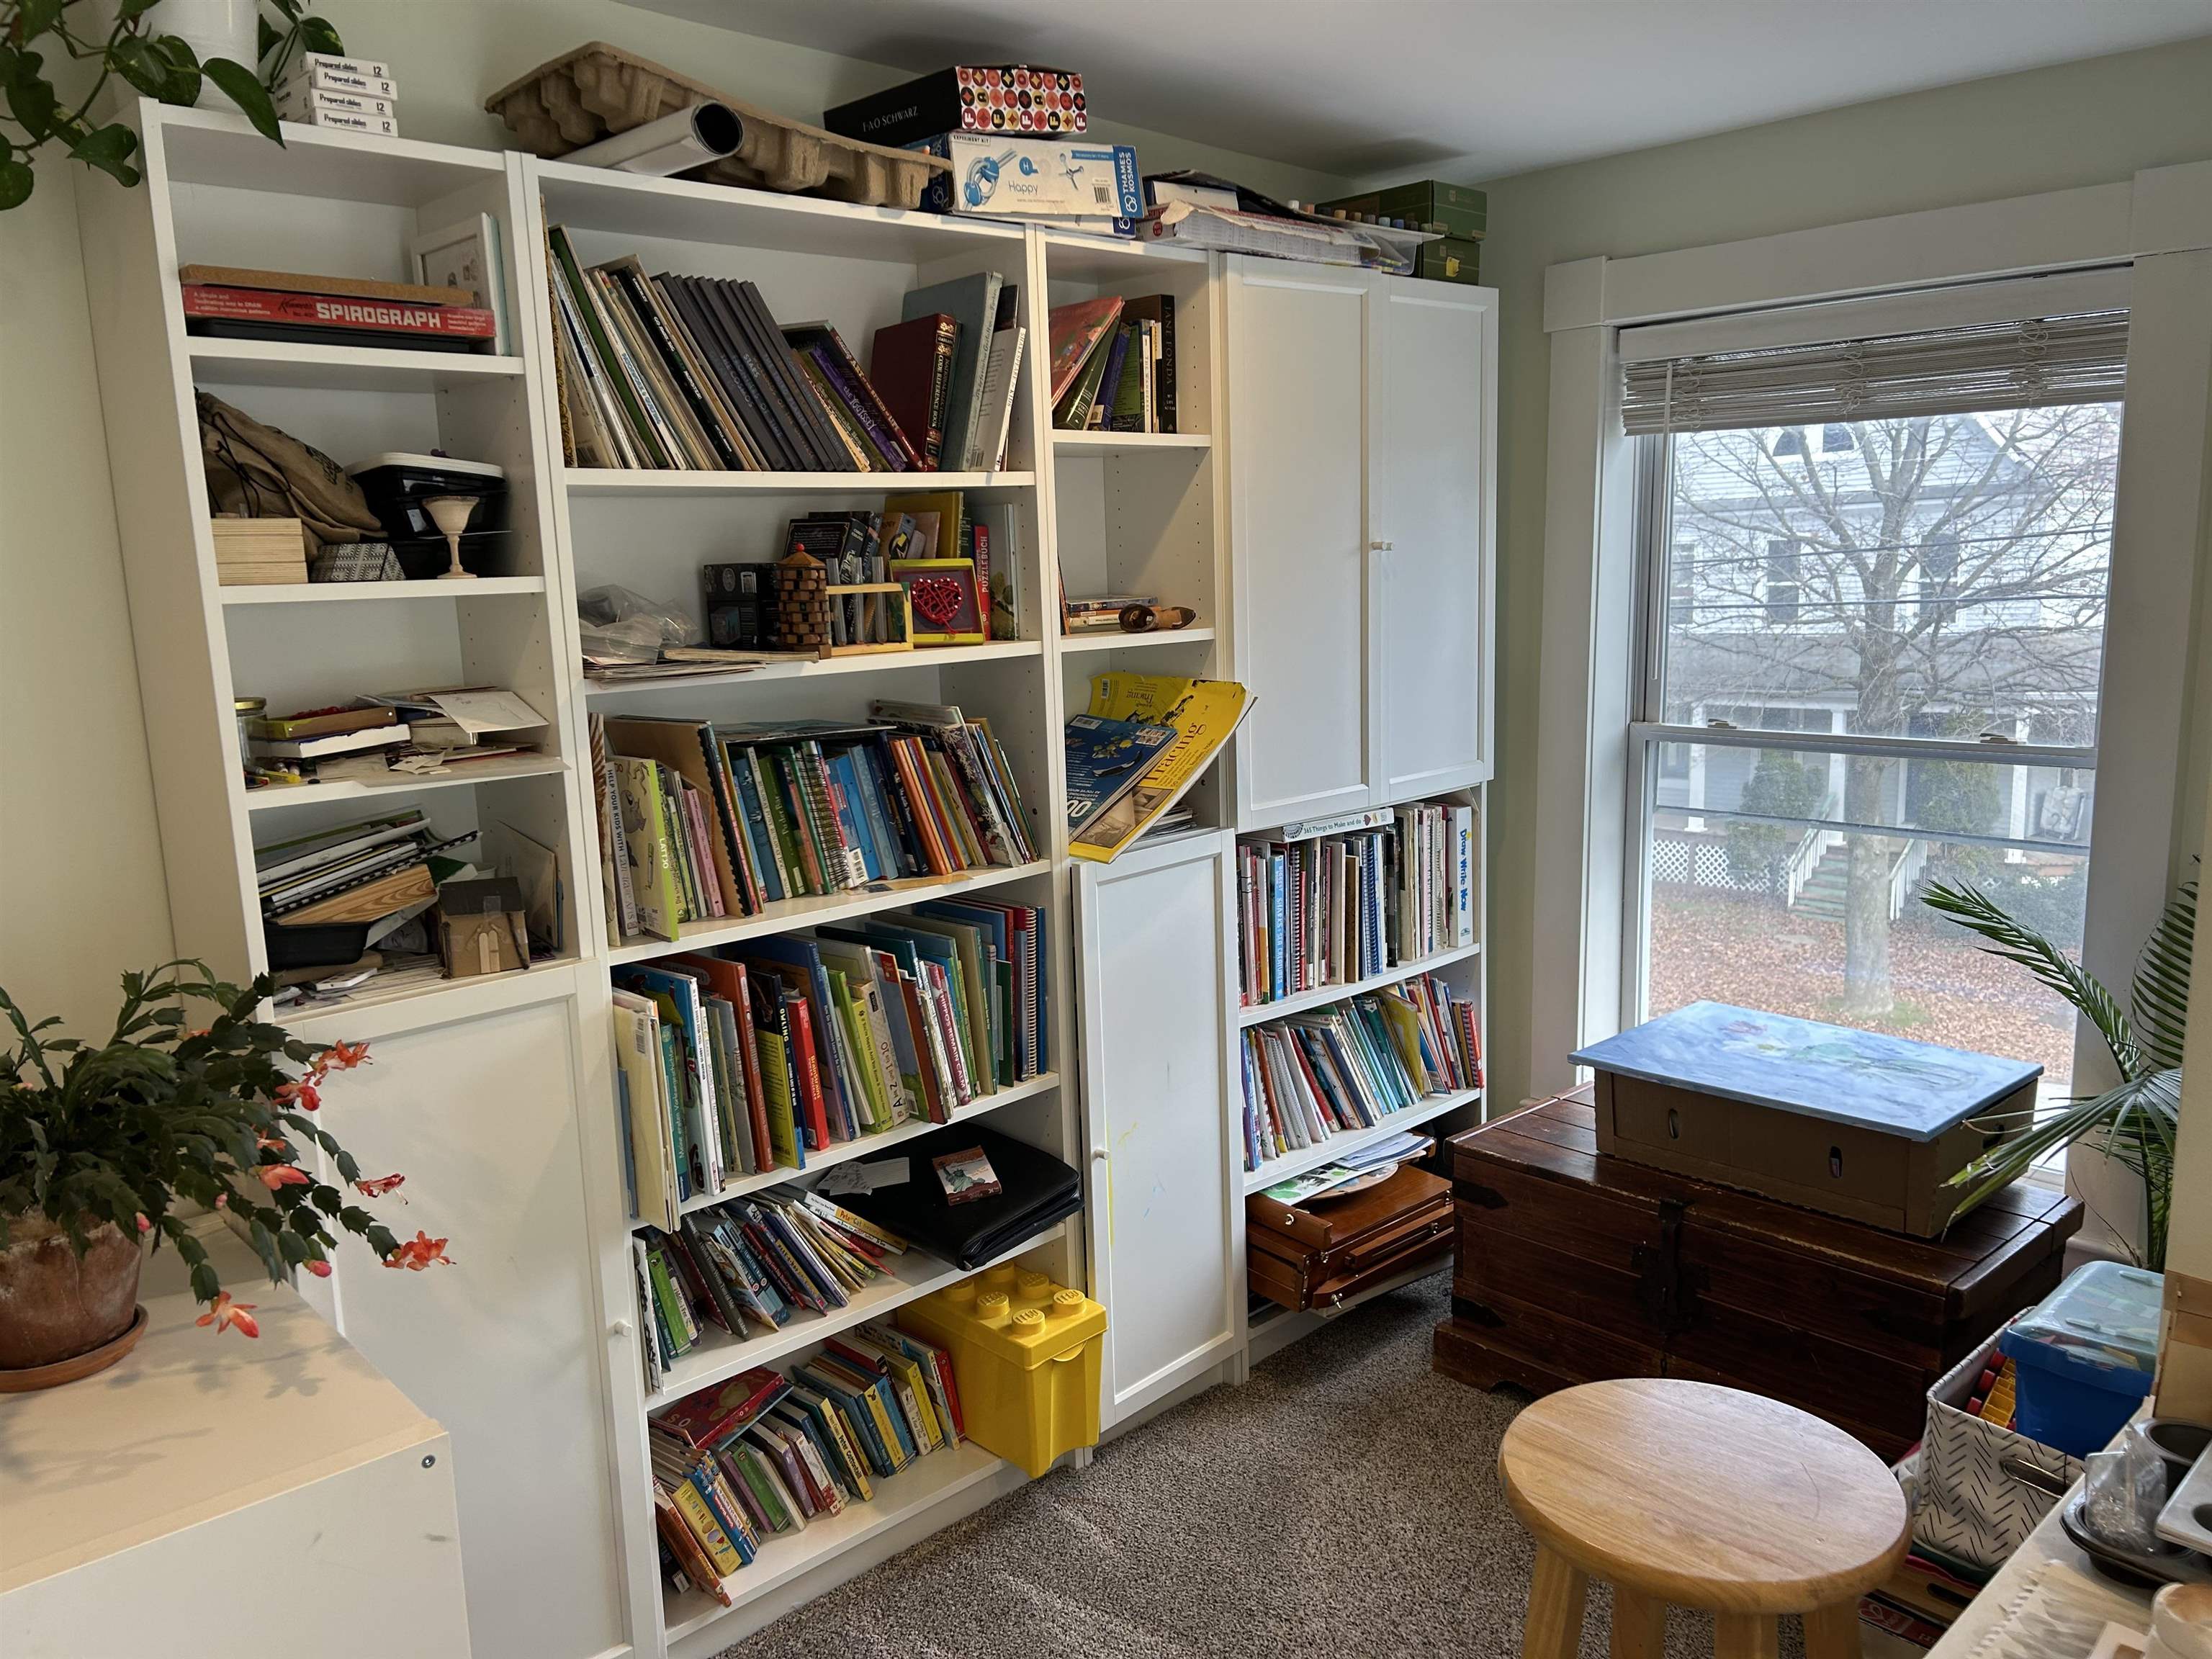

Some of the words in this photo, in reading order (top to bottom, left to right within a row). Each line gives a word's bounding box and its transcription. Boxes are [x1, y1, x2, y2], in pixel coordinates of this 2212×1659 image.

[315, 58, 341, 68] Prepared
[342, 63, 358, 71] slides
[373, 66, 382, 76] 12
[324, 72, 350, 83] Prepared
[351, 78, 367, 86] slides
[381, 81, 390, 91] 12
[319, 94, 345, 104] Prepared
[346, 98, 361, 107] slides
[376, 102, 385, 112] 12
[324, 113, 350, 124] Prepared
[351, 118, 367, 127] slides
[382, 121, 391, 130] 12
[882, 105, 920, 129] SCHWARZ
[1119, 152, 1128, 194] THAMES
[1125, 152, 1136, 193] KOSMOS
[1008, 181, 1038, 195] Happy
[316, 302, 441, 328] SPIROGRAPH
[741, 353, 762, 379] STARS
[727, 372, 757, 408] COSMOS
[785, 397, 811, 429] PLANET
[766, 418, 785, 440] TIME
[609, 789, 618, 810] YOUR
[613, 811, 621, 830] KIDS
[757, 780, 769, 809] RUNAWAY
[769, 827, 781, 856] RUNAWAY
[1312, 824, 1328, 834] Things
[616, 831, 624, 852] WITH
[658, 837, 670, 869] LATTJO
[779, 1007, 789, 1042] OWLING
[879, 1041, 889, 1054] 10
[939, 994, 951, 1027] HIPPOS
[947, 1028, 959, 1061] REMAIN
[955, 1063, 966, 1088] CALM
[891, 1096, 904, 1108] A
[839, 1210, 851, 1220] Pete
[837, 1434, 848, 1450] Peter
[845, 1449, 863, 1480] Cottontail
